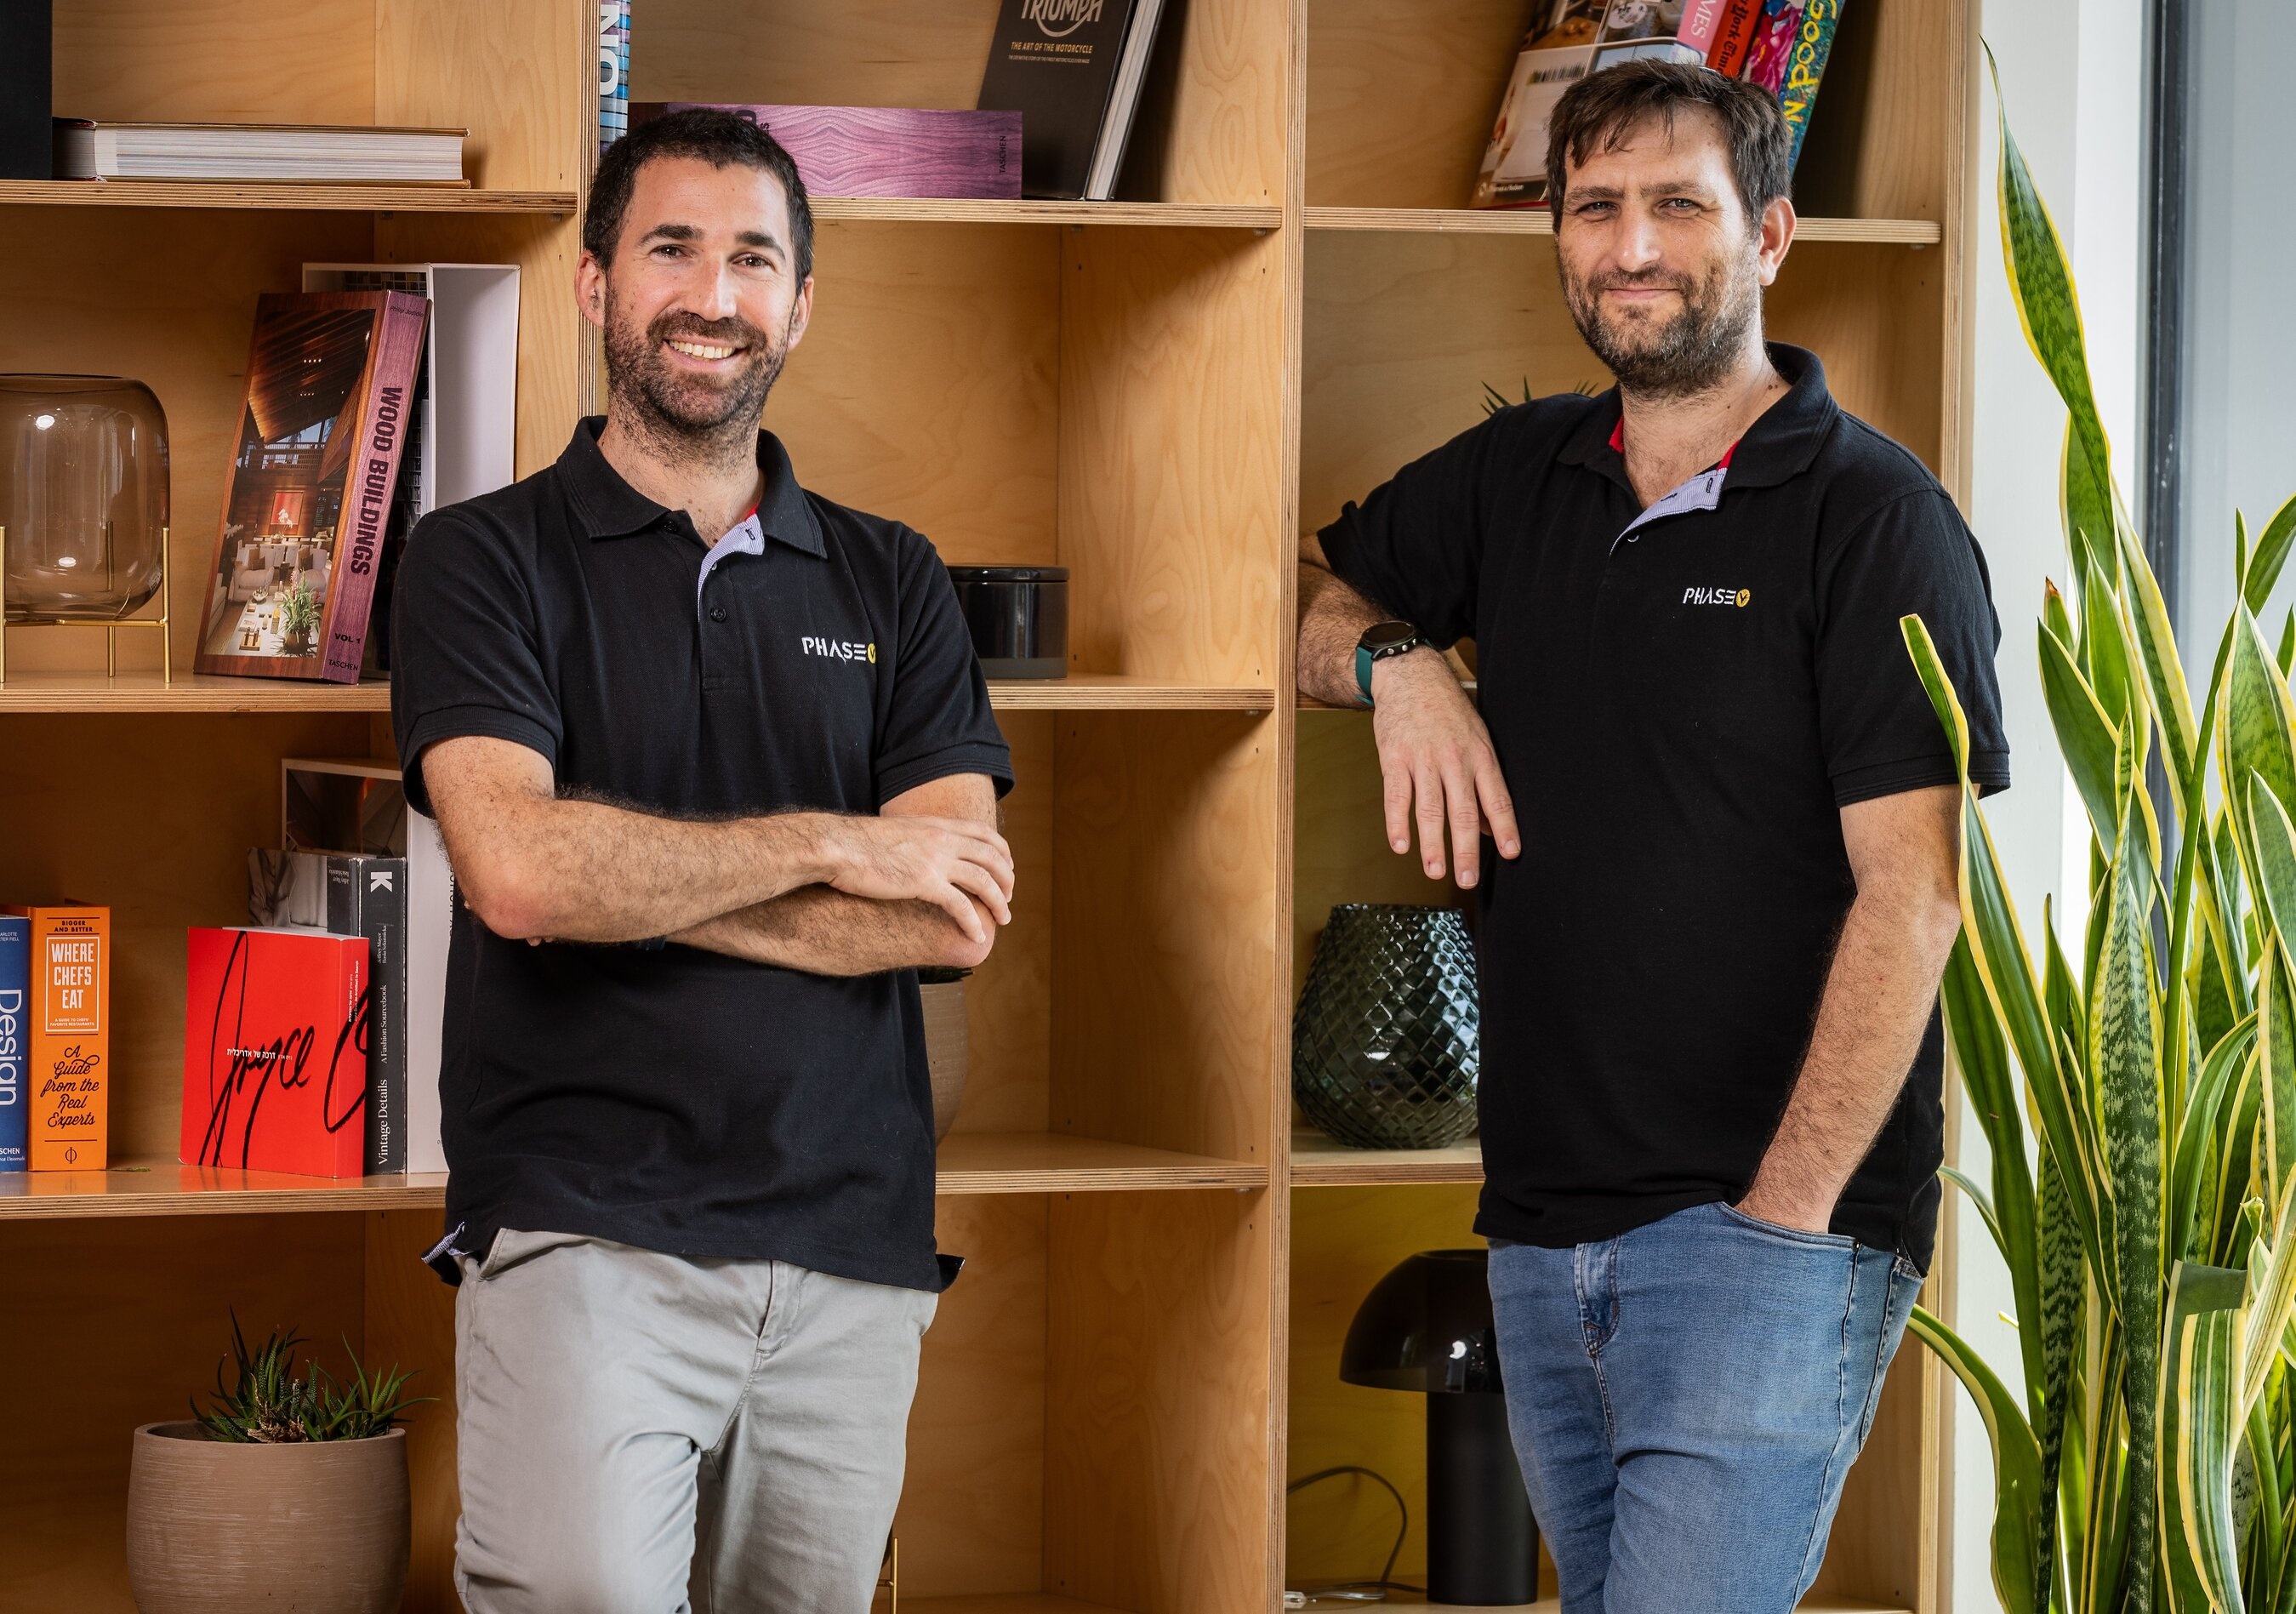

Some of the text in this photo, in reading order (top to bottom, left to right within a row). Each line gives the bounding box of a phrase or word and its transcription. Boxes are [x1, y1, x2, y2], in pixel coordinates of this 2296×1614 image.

[1020, 0, 1104, 25] TRIUMPH
[1691, 0, 1718, 38] MES
[1728, 4, 1749, 41] York
[1011, 42, 1094, 54] THE ART OF THE MOTORCYCLE
[1717, 41, 1738, 74] Time
[350, 387, 403, 576] WOOD BUILDINGS
[334, 632, 355, 644] VOL
[328, 659, 359, 671] TASCHEN
[51, 942, 94, 963] WHERE
[54, 966, 92, 986] CHEFS
[61, 989, 84, 1010] EAT
[379, 984, 388, 1028] Sourcebook
[64, 1045, 81, 1058] A
[226, 1047, 253, 1058] אדריכלית
[379, 1028, 388, 1057] Fashion
[253, 1049, 261, 1058] של
[262, 1052, 276, 1060] דרכה
[54, 1054, 100, 1080] Guide
[40, 1078, 100, 1098] from the
[57, 1093, 88, 1114] Real
[47, 1111, 96, 1130] Experts
[377, 1079, 390, 1165] Vintage Details
